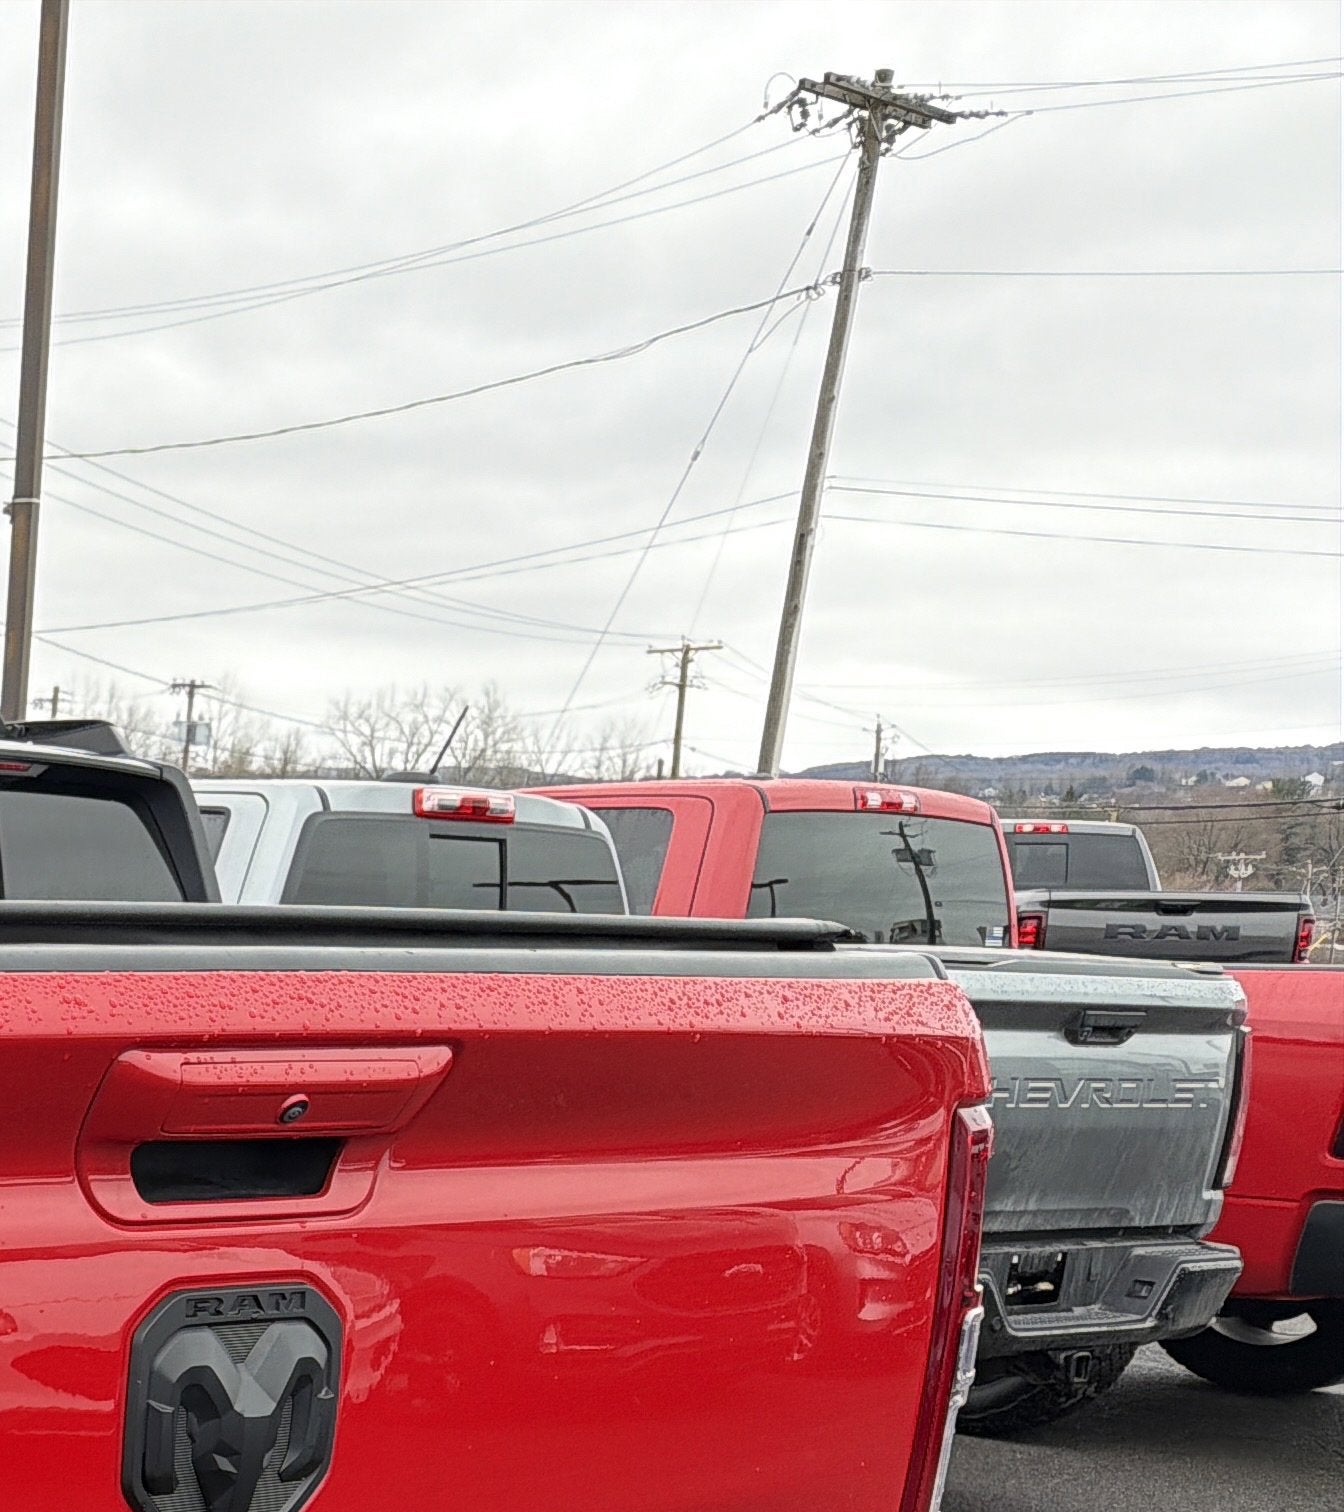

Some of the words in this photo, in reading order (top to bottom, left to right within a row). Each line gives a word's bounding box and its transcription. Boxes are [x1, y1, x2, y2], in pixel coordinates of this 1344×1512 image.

[1103, 922, 1241, 941] RAM
[983, 1076, 1226, 1108] HEVROLET
[184, 1291, 307, 1318] RAM
